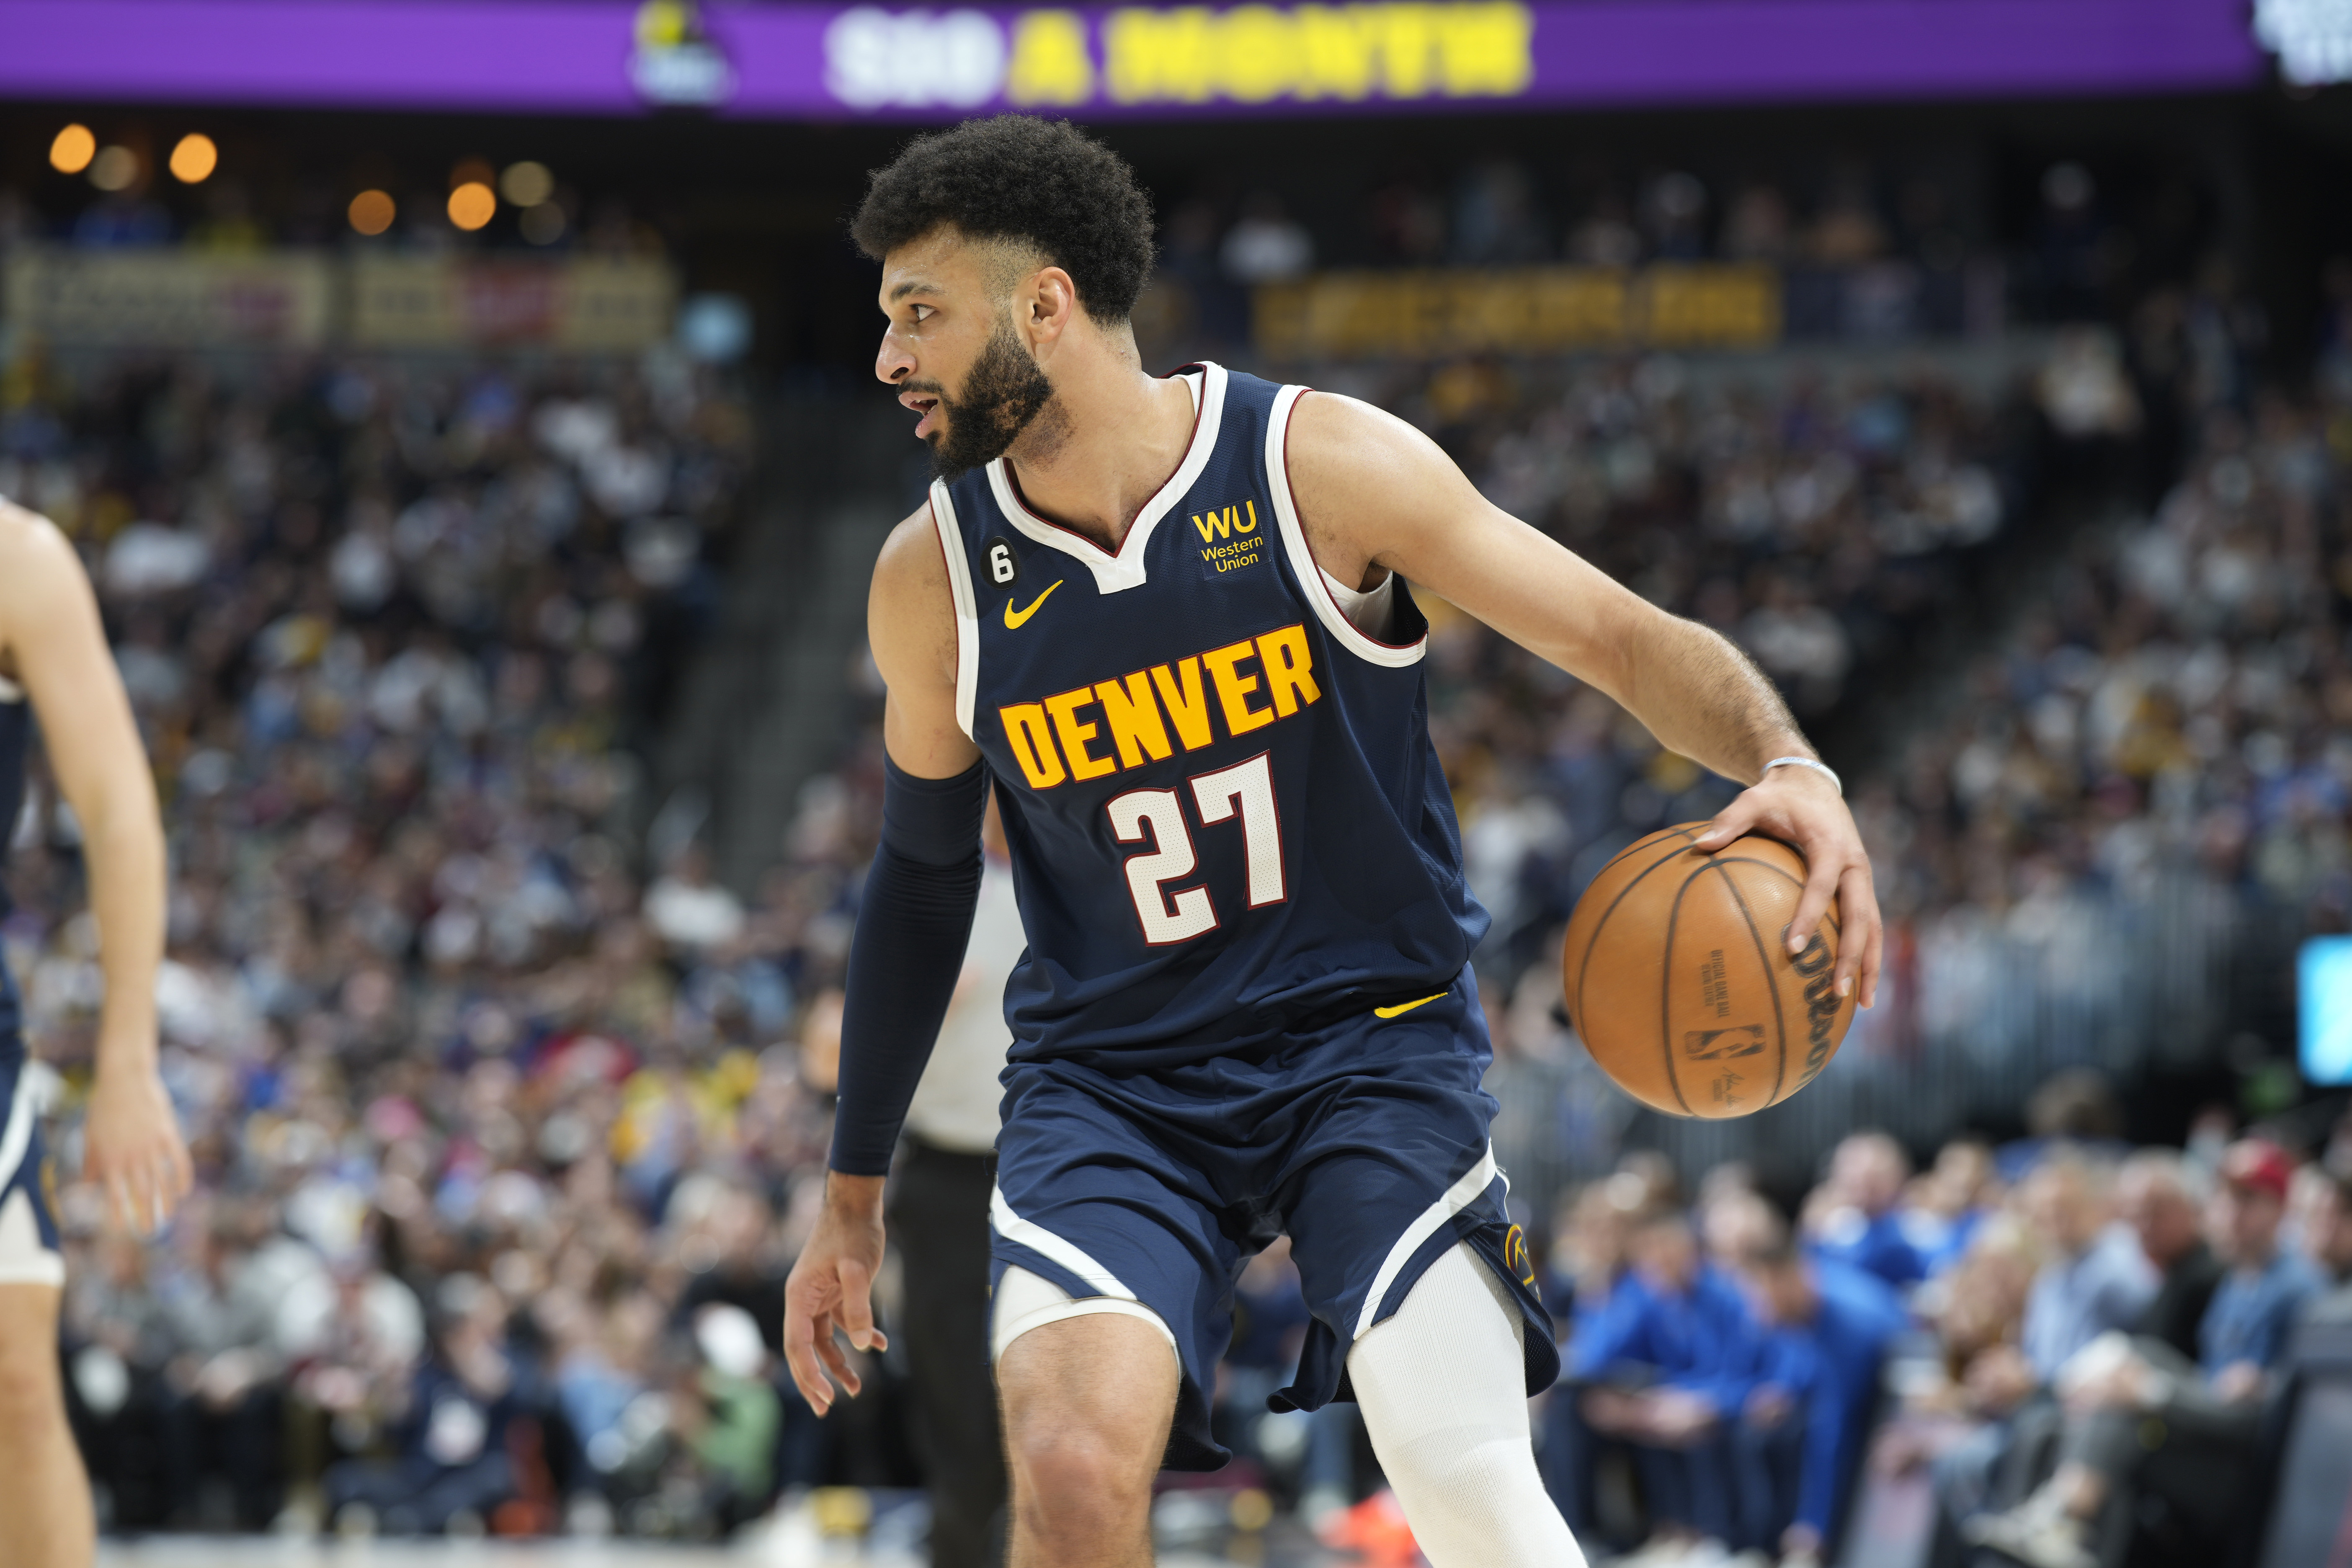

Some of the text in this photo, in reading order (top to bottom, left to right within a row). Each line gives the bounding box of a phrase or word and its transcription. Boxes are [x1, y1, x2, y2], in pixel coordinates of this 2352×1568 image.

[1009, 9, 1091, 106] A
[1105, 4, 1533, 103] MONTH
[1192, 500, 1256, 543] WU
[1201, 536, 1263, 562] Western
[990, 544, 1014, 583] 6
[1215, 553, 1259, 572] Union
[998, 622, 1322, 790] DENVER
[1104, 749, 1287, 946] 27
[1711, 949, 1730, 1017] OFFICIAL GAME BALL
